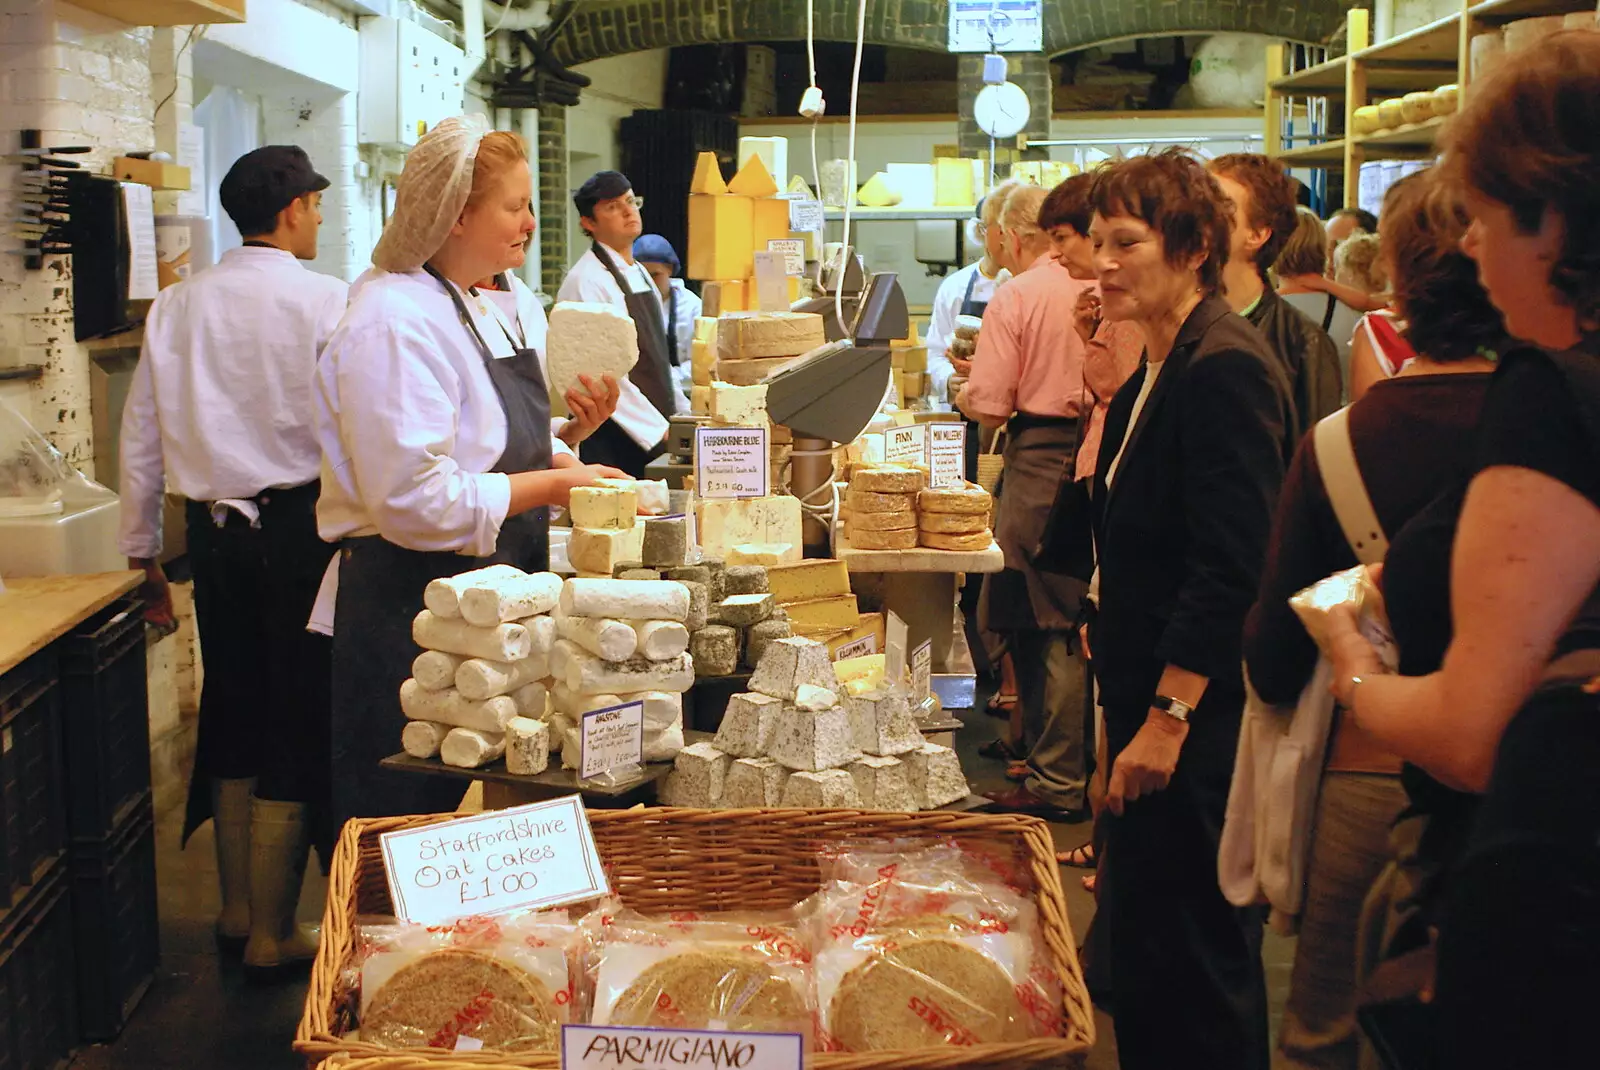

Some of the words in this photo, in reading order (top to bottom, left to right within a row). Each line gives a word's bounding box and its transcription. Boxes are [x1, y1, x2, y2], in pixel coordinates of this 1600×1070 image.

[703, 435, 742, 447] HARBOURNE
[743, 435, 760, 446] BLUE
[895, 431, 913, 444] FINN
[419, 817, 567, 860] Staffordshire
[414, 857, 474, 888] Oat
[486, 844, 555, 872] Cakes
[582, 1034, 756, 1069] PARMIGIANO
